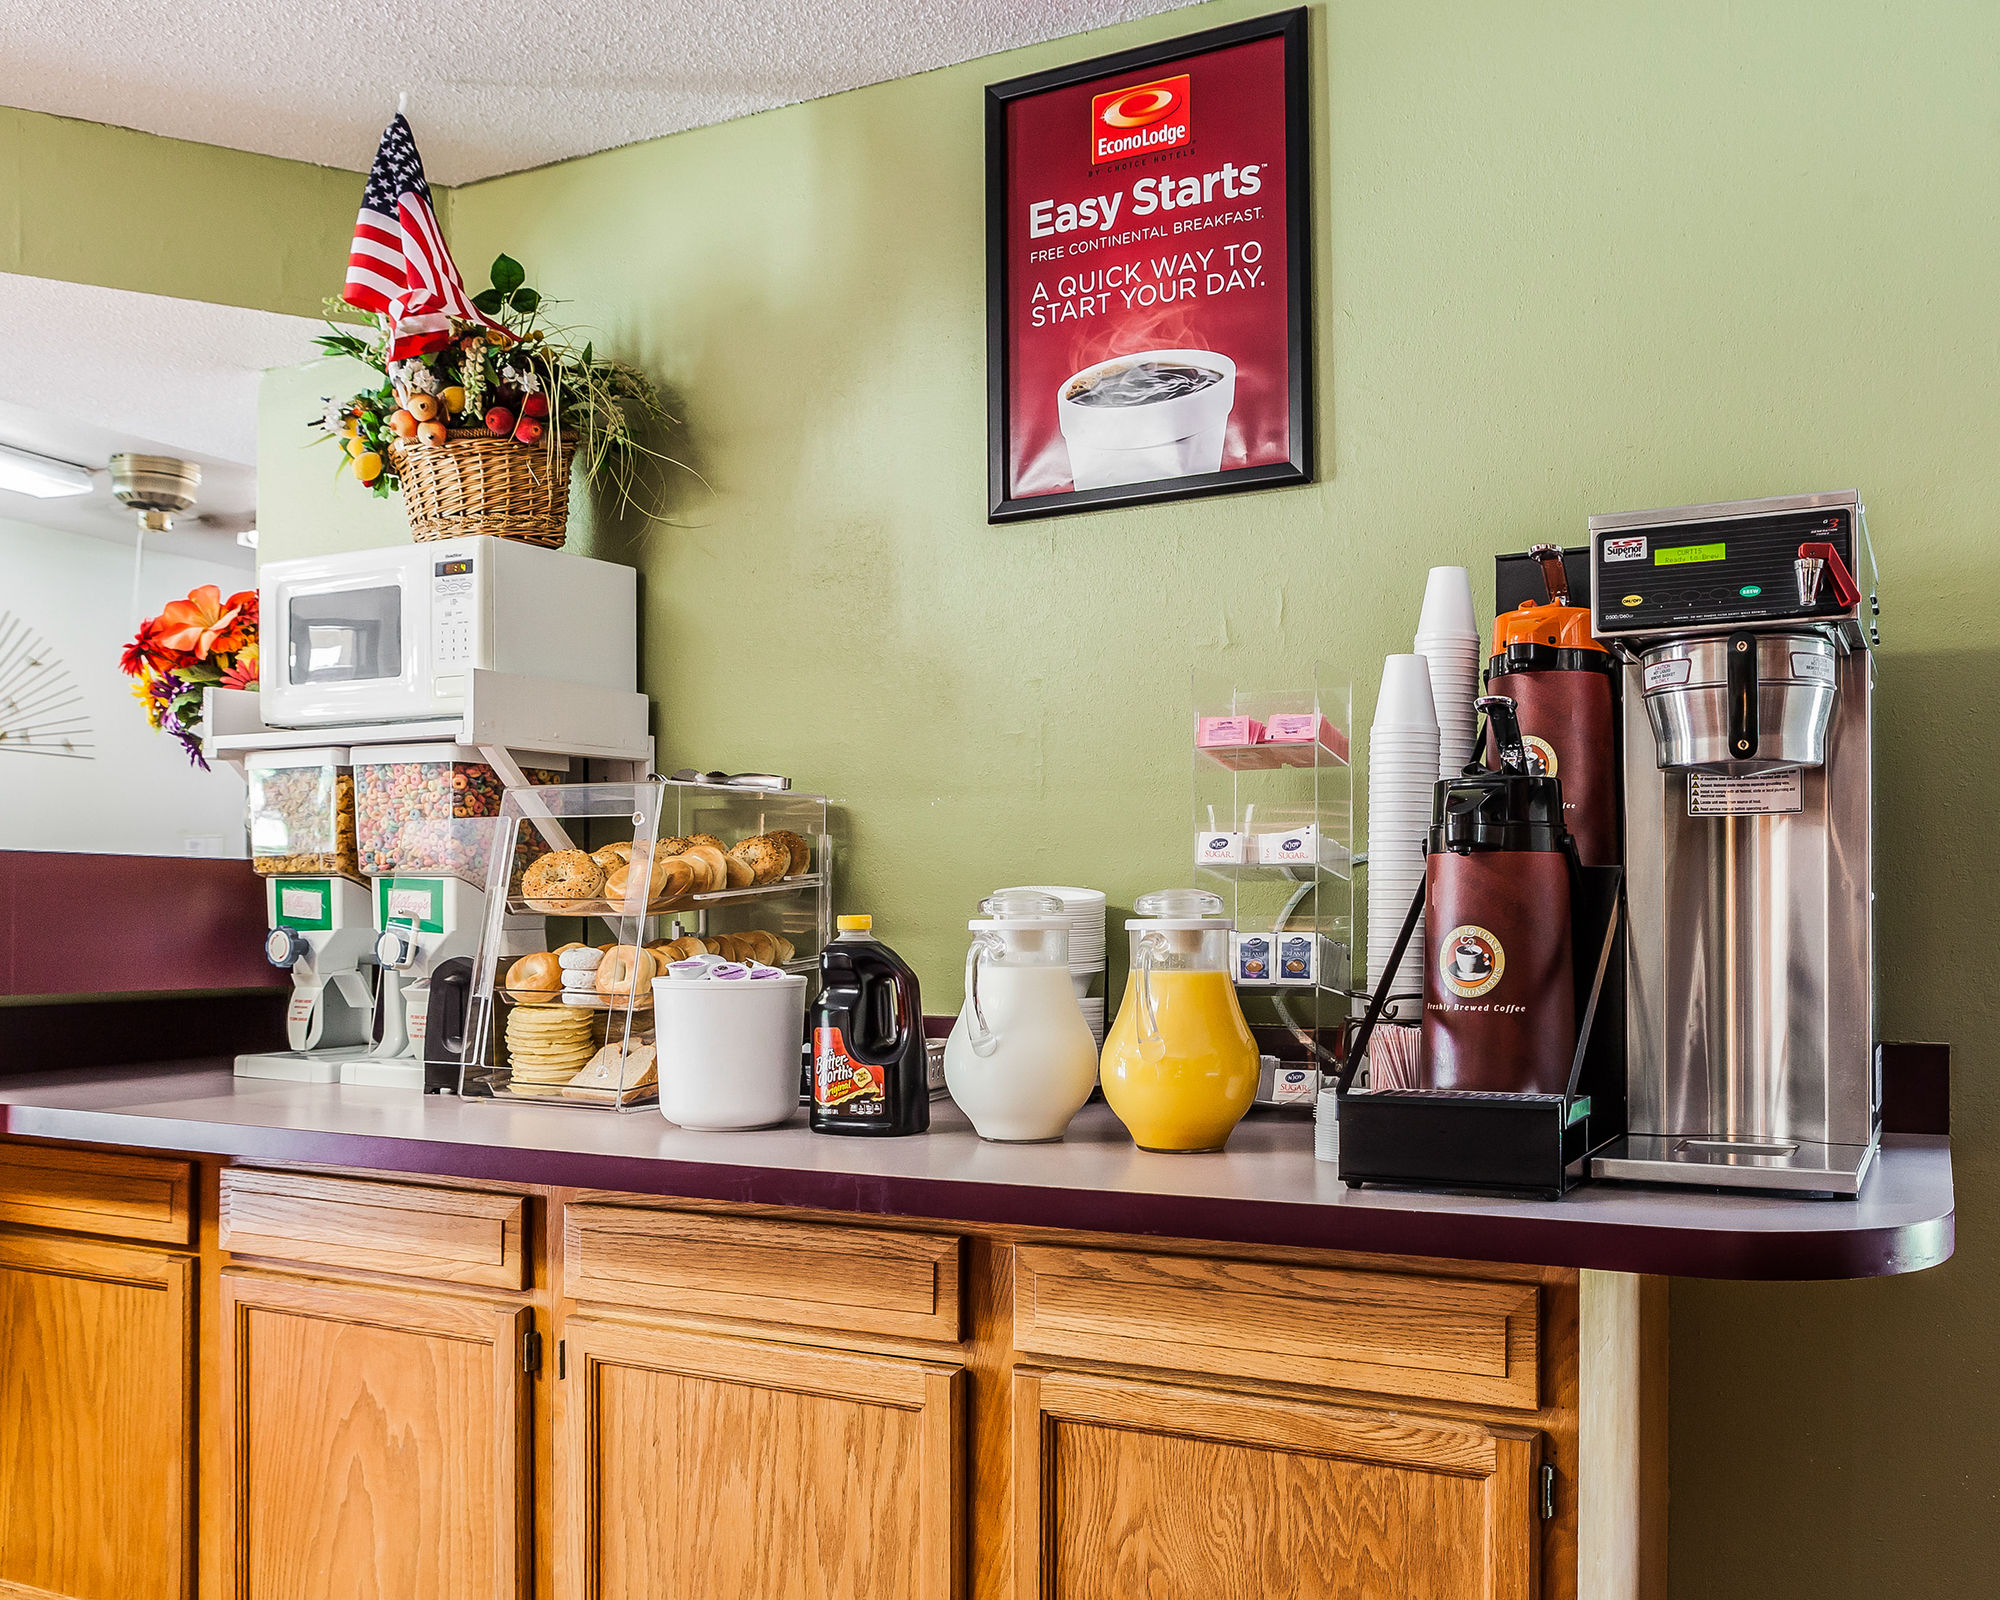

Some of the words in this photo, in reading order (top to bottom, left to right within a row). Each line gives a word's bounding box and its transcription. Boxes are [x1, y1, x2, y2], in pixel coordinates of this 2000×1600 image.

[1098, 123, 1186, 157] EconoLodge
[1088, 168, 1100, 178] BY
[1107, 158, 1147, 173] CHOICE
[1154, 148, 1196, 163] HOTELS
[1029, 191, 1123, 240] Easy
[1030, 246, 1065, 264] FREE
[1069, 225, 1168, 256] CONTINENTAL
[1173, 206, 1265, 234] BREAKFAST.
[1031, 281, 1049, 304] A
[1057, 262, 1142, 295] QUICK
[1150, 248, 1214, 279] WAY
[1223, 241, 1262, 266] TO
[1031, 294, 1112, 328] START
[1120, 279, 1197, 309] YOUR
[1206, 265, 1266, 295] DAY.
[1742, 587, 1760, 595] BREW
[1204, 850, 1232, 858] SUGAR
[1278, 851, 1305, 859] SUGAR
[1479, 929, 1503, 955] COAST
[1427, 1002, 1450, 1012] Freshly
[1453, 1003, 1490, 1012] Brewed
[1493, 1004, 1526, 1014] Coffee
[1280, 1083, 1308, 1091] SUGAR
